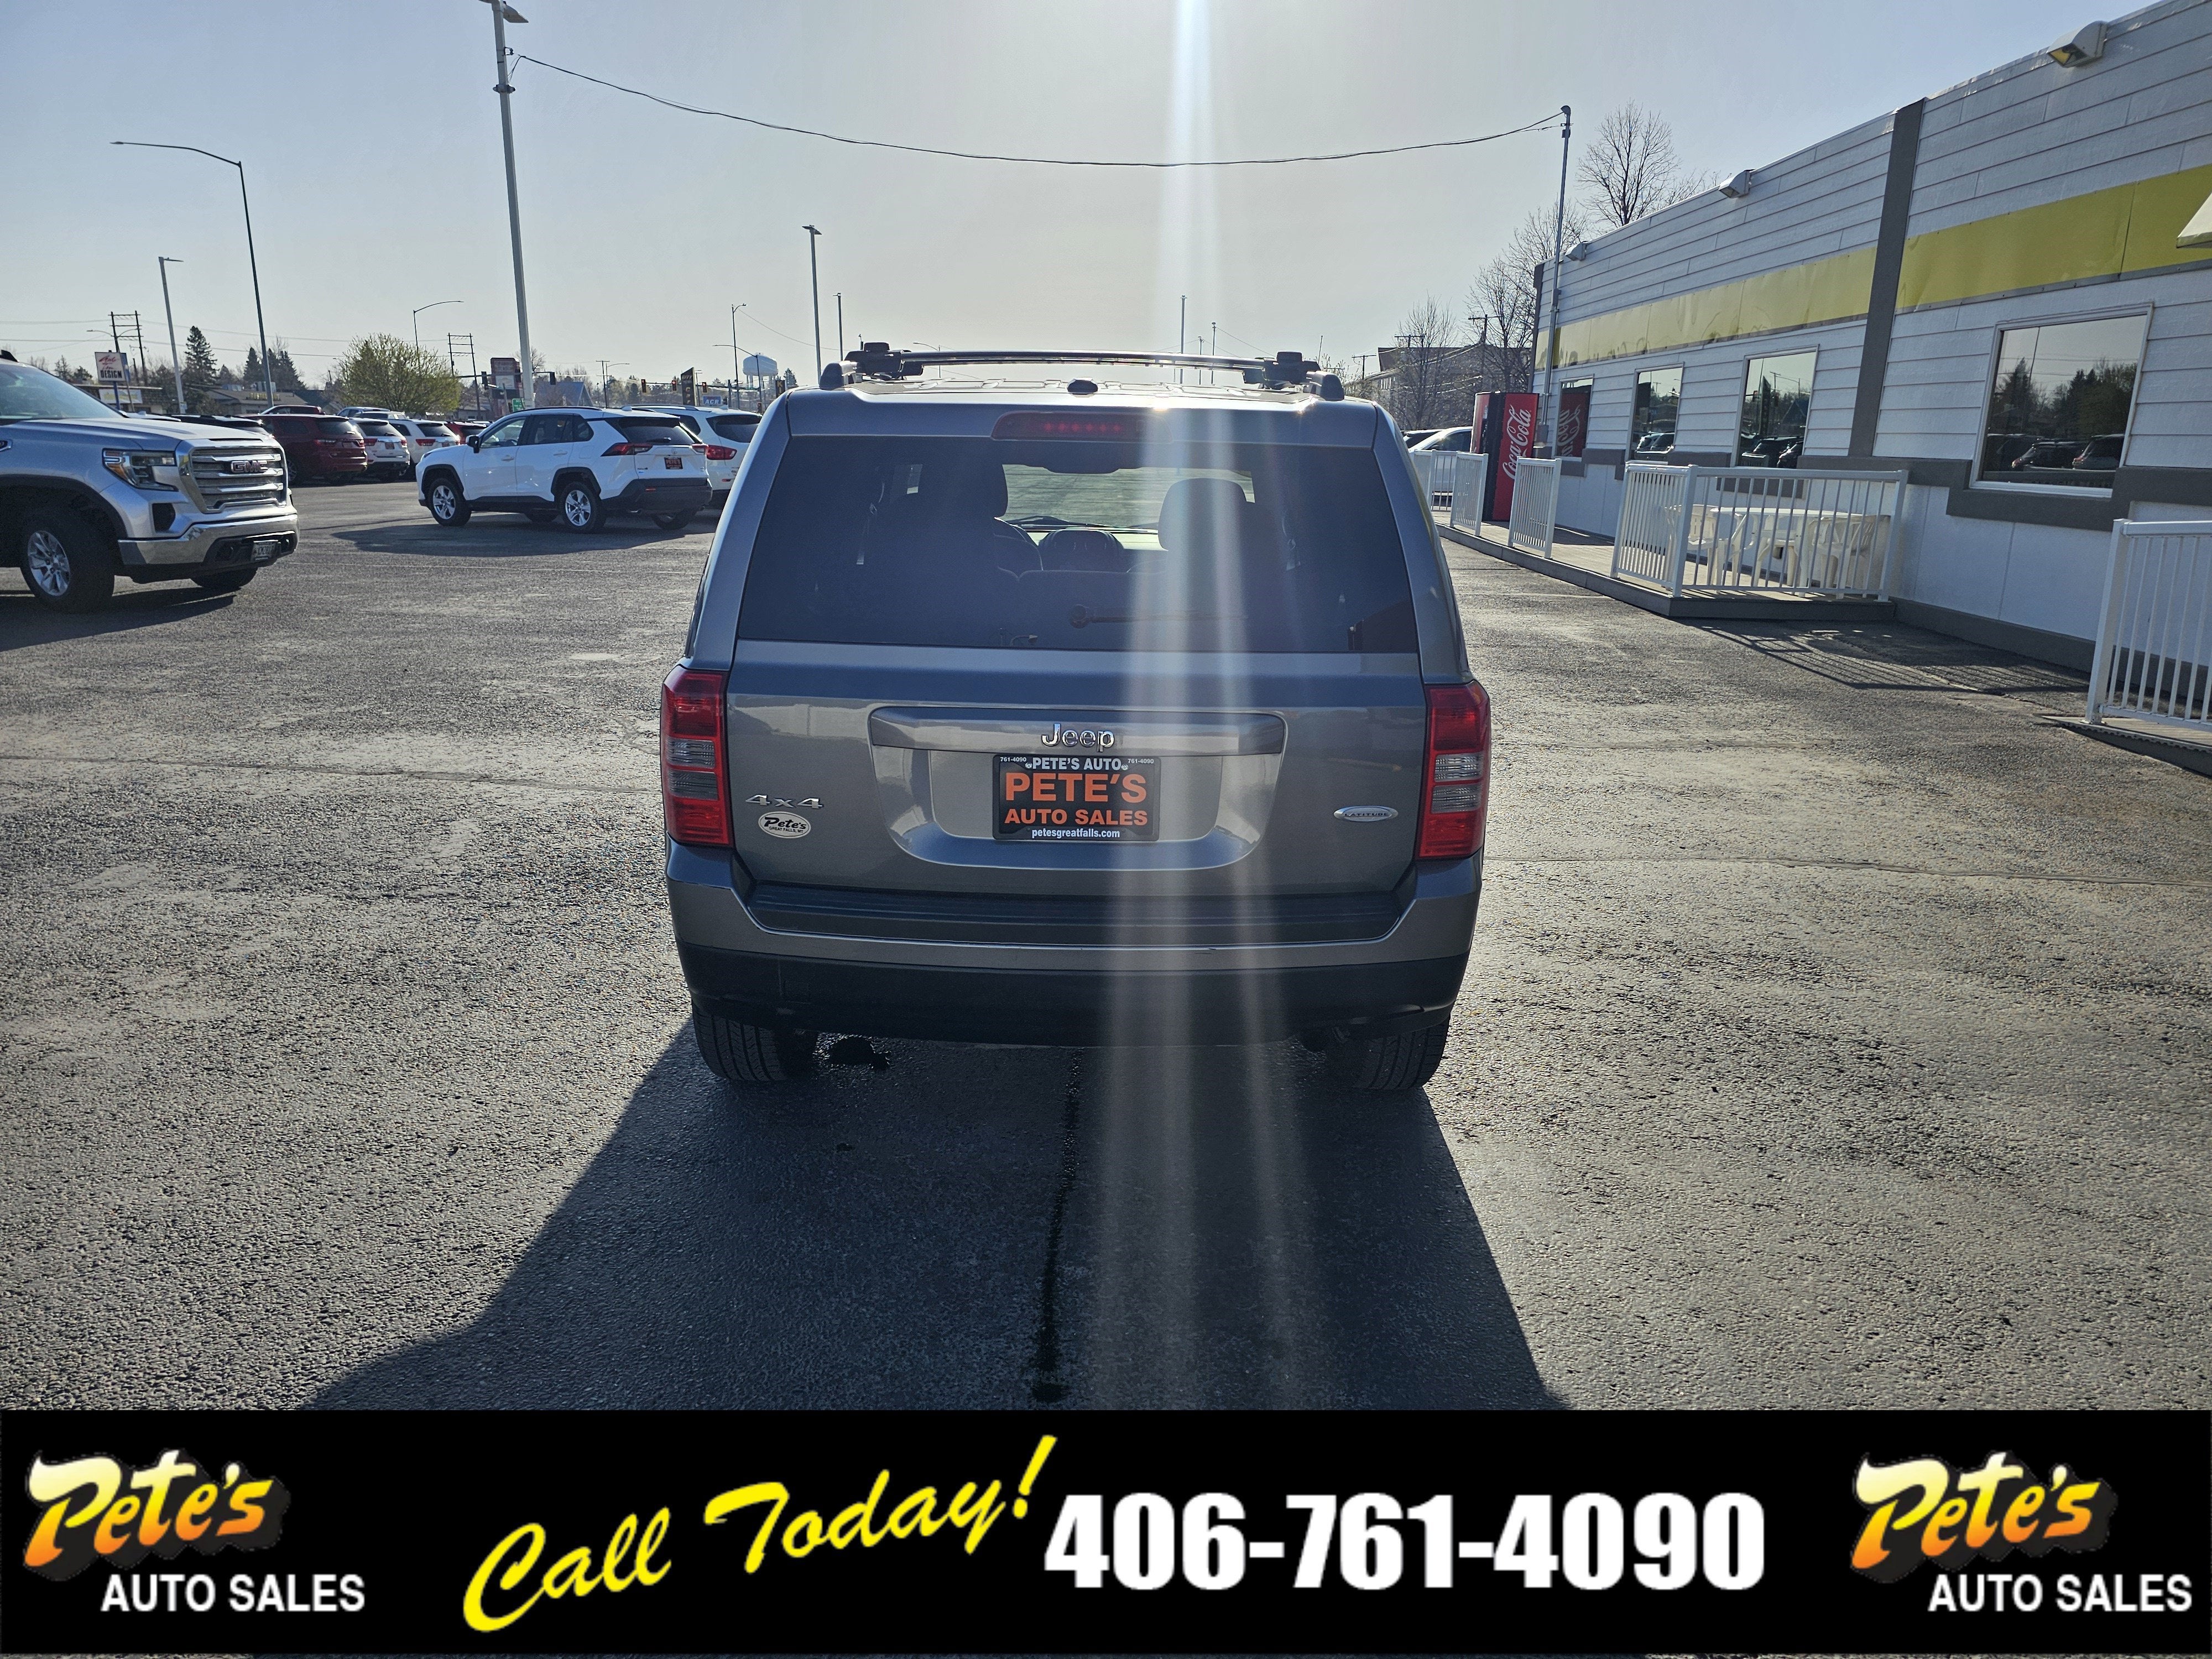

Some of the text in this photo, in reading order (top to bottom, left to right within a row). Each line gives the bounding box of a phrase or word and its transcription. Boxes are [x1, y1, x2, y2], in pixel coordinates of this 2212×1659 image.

[100, 370, 122, 378] DESIGN
[231, 460, 268, 473] GMC
[1041, 723, 1115, 752] Jeep
[1032, 758, 1121, 770] PETE'S AUTO
[1005, 773, 1146, 802] PETE'S
[745, 795, 823, 808] 4x4
[764, 816, 807, 830] Pete's
[1004, 808, 1147, 825] AUTO SALES
[1032, 828, 1120, 839] petesgreatfalls.com
